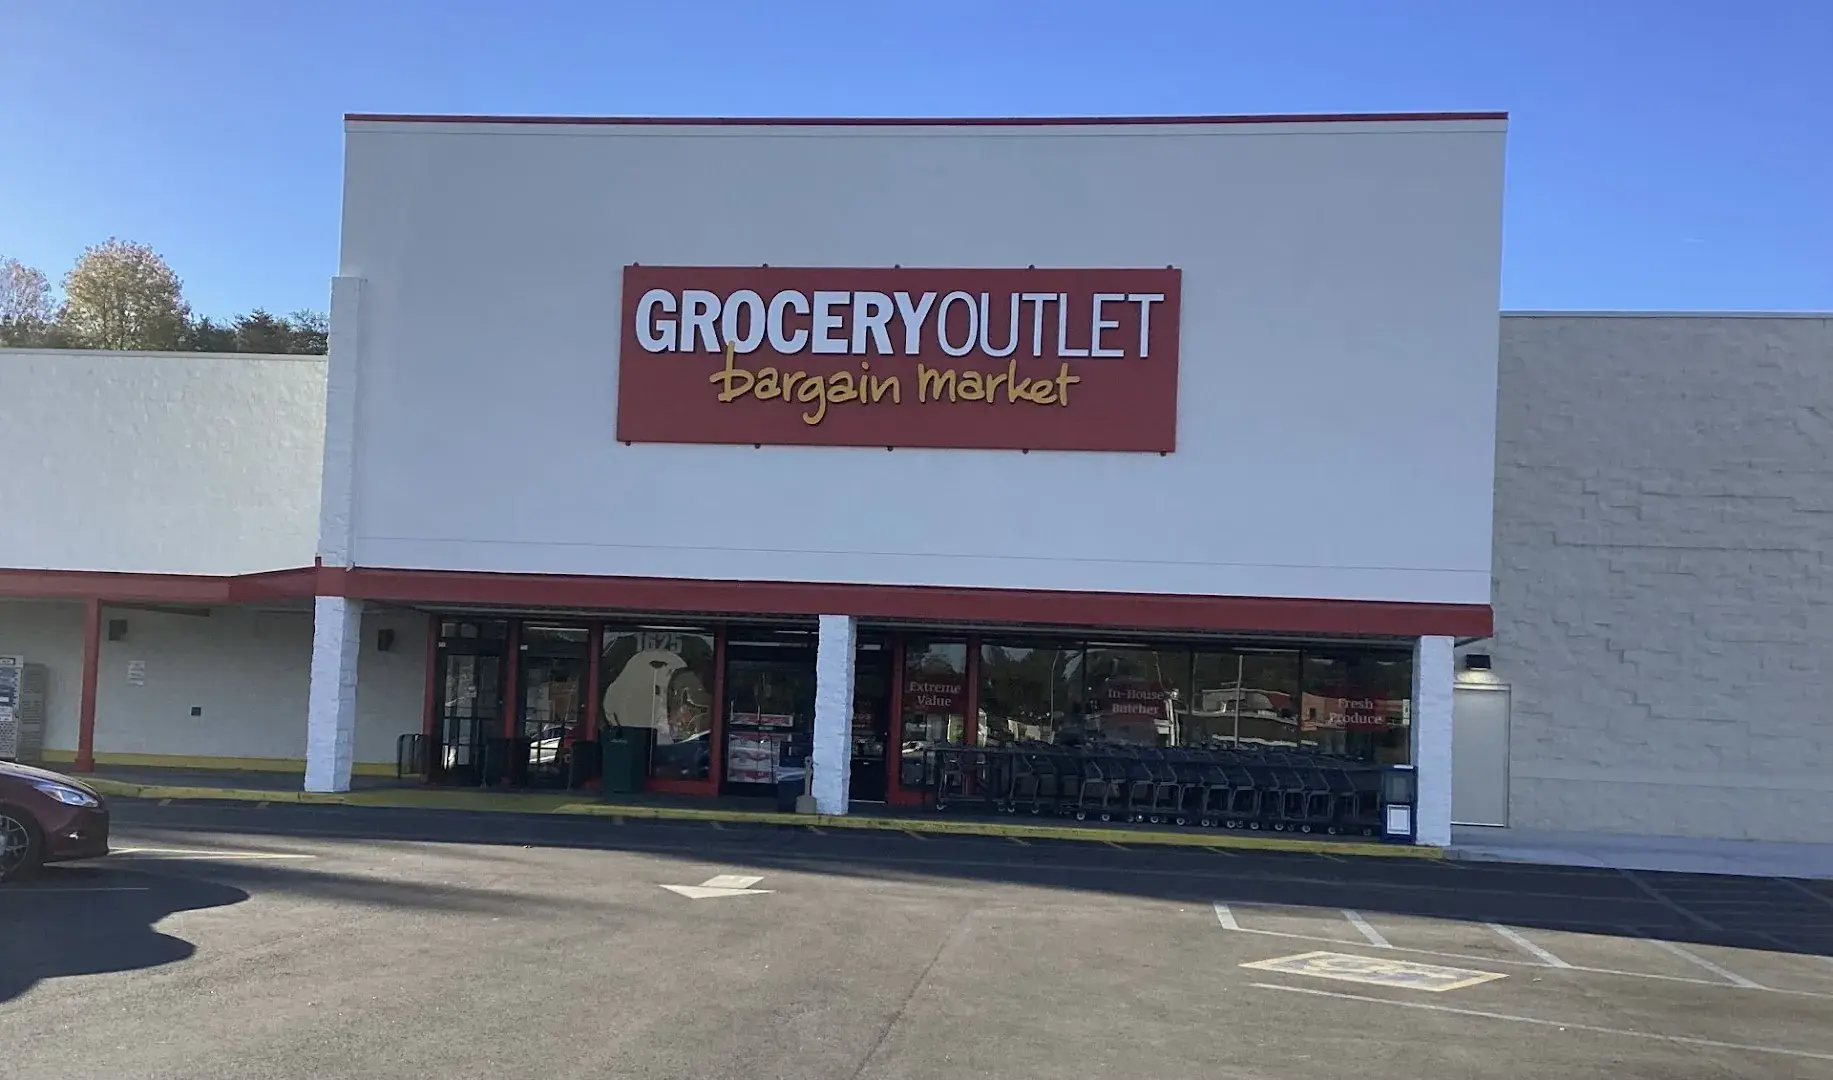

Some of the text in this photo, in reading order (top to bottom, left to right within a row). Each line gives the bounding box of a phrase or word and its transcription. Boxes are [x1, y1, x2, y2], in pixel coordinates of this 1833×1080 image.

[709, 340, 1081, 425] bargain market
[909, 681, 962, 694] Extreme
[1107, 688, 1165, 700] In-House
[917, 695, 952, 707] Value
[1338, 698, 1374, 710] Fresh
[1112, 703, 1160, 715] Butcher
[1328, 712, 1384, 725] Produce
